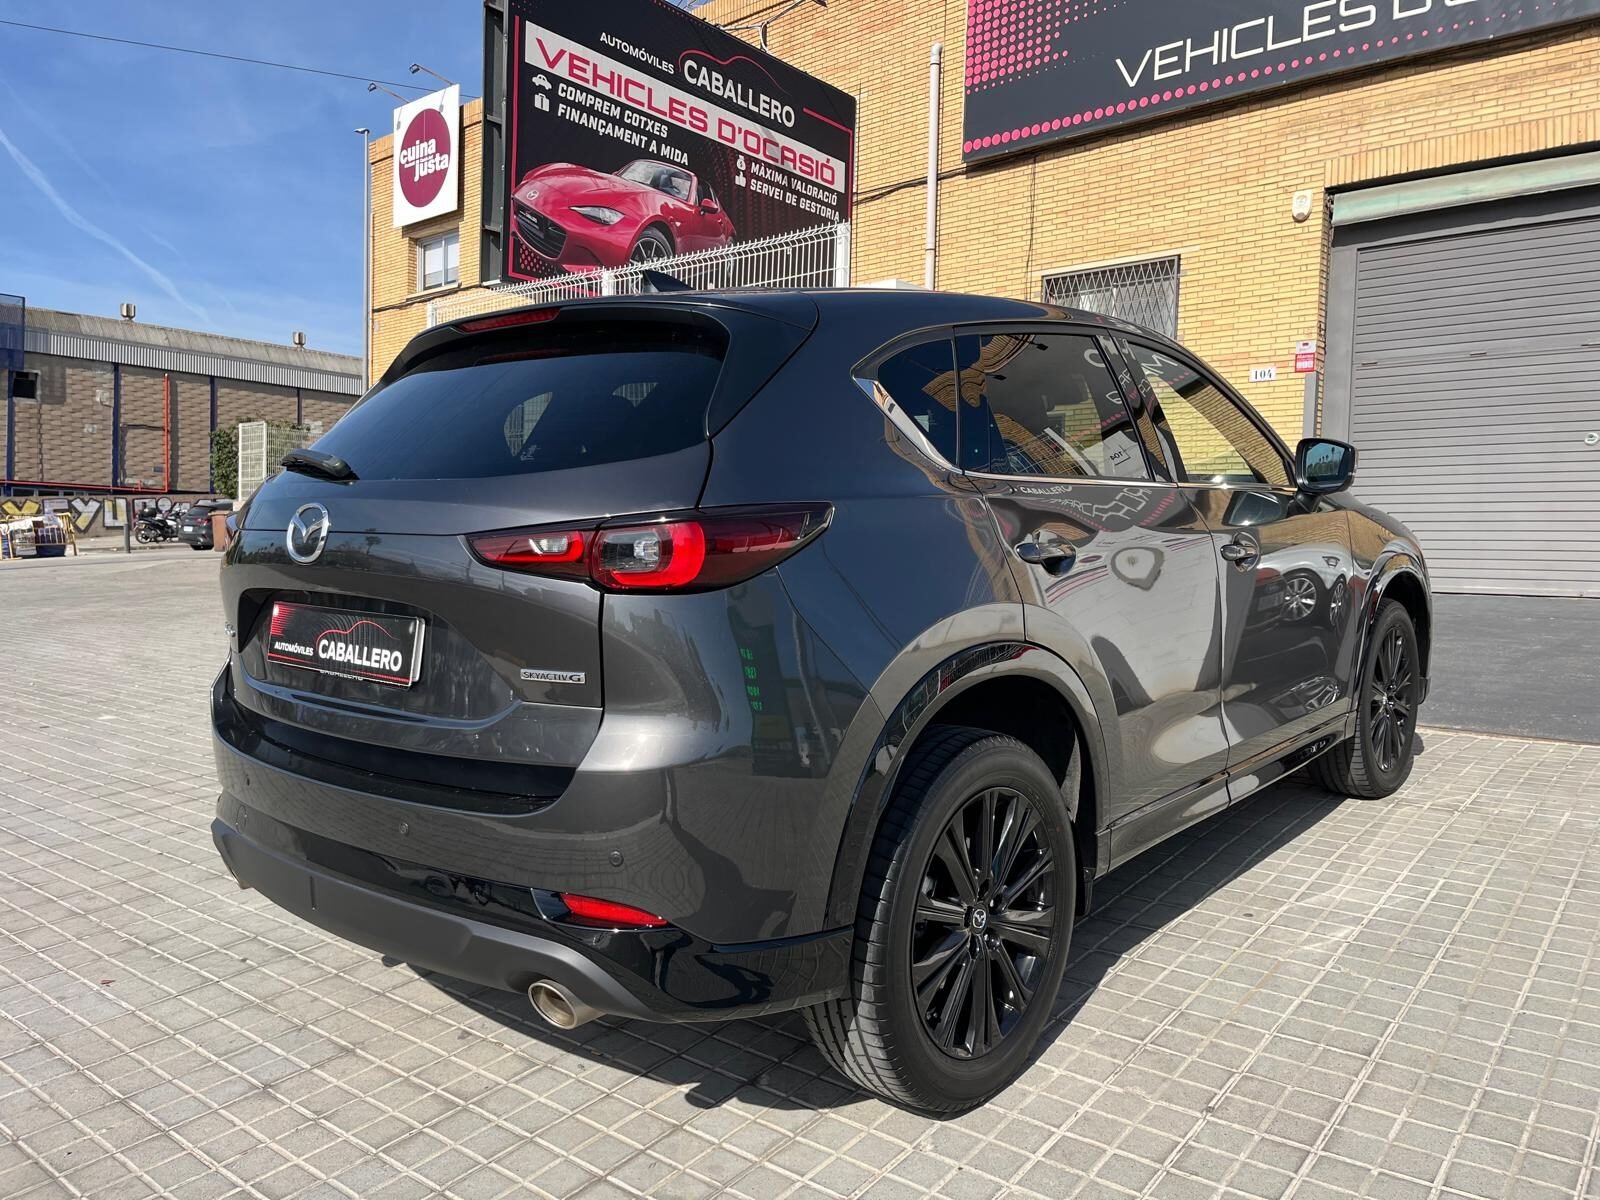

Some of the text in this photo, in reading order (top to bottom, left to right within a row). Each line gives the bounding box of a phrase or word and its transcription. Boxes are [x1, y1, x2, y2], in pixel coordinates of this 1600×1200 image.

[1115, 0, 1376, 87] VEHICLES
[600, 32, 795, 127] AUTOMÓVILES CABALLERO
[536, 37, 835, 186] VEHICLES D'OCASIÓ
[558, 83, 668, 138] COMPREM COTXES
[399, 138, 436, 165] cuina
[558, 103, 689, 166] FINANÇAMENT A MIDA
[414, 152, 449, 182] justa
[751, 162, 838, 206] MÀXIMA VALORACIÓ
[750, 179, 840, 222] SERVEI DE GESTORIA
[1254, 369, 1272, 380] 104
[274, 639, 403, 672] AUTOMÓVILES CABALLERO
